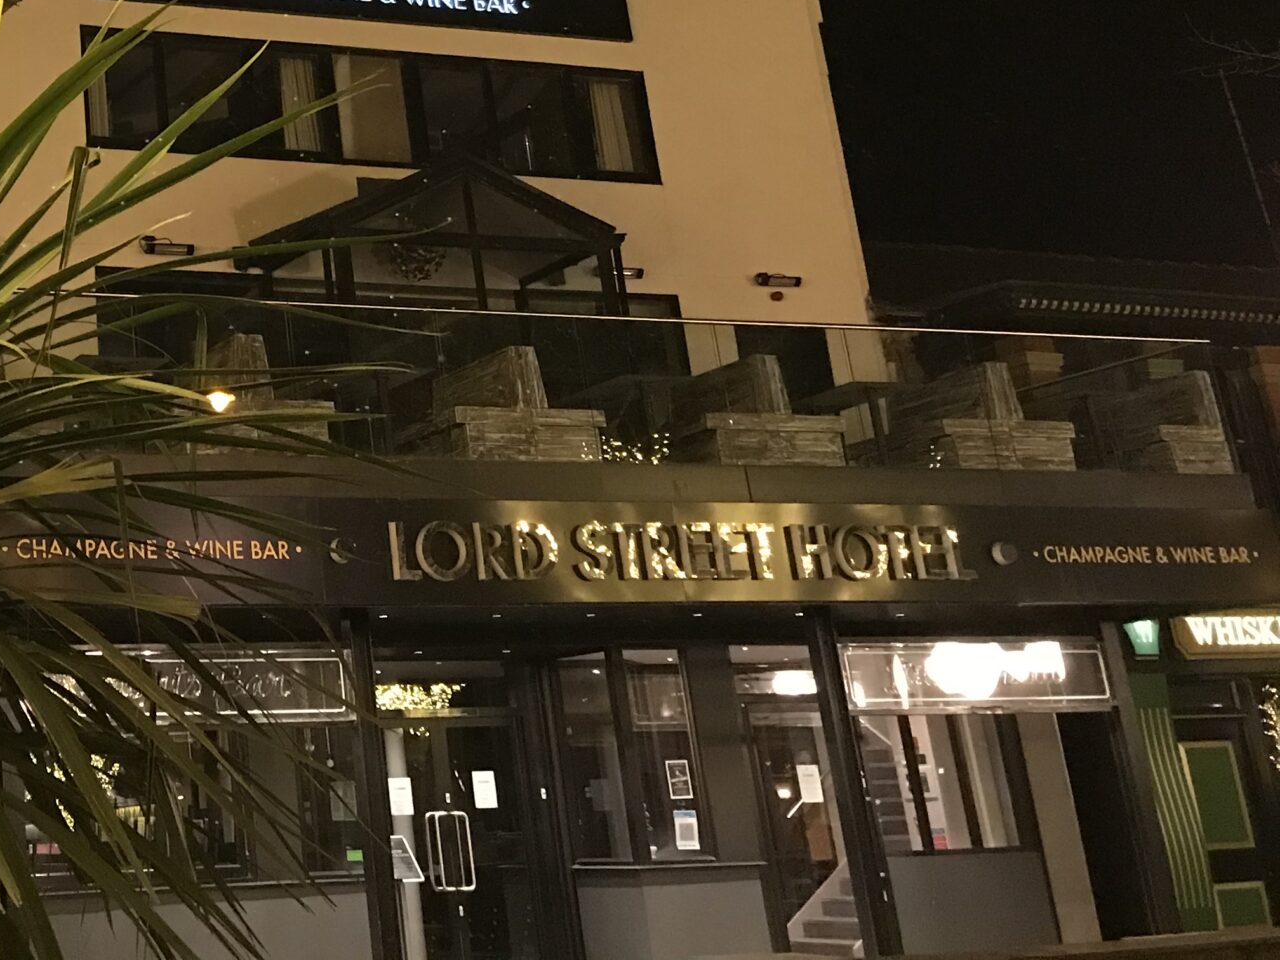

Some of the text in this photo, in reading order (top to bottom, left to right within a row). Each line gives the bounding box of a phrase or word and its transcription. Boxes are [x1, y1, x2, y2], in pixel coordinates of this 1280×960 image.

[251, 540, 290, 560] BAR
[388, 520, 979, 581] LORD STREET HOTEL
[1044, 546, 1251, 563] CHAMPAGNE & WINE BAR
[1184, 616, 1280, 645] WHISK
